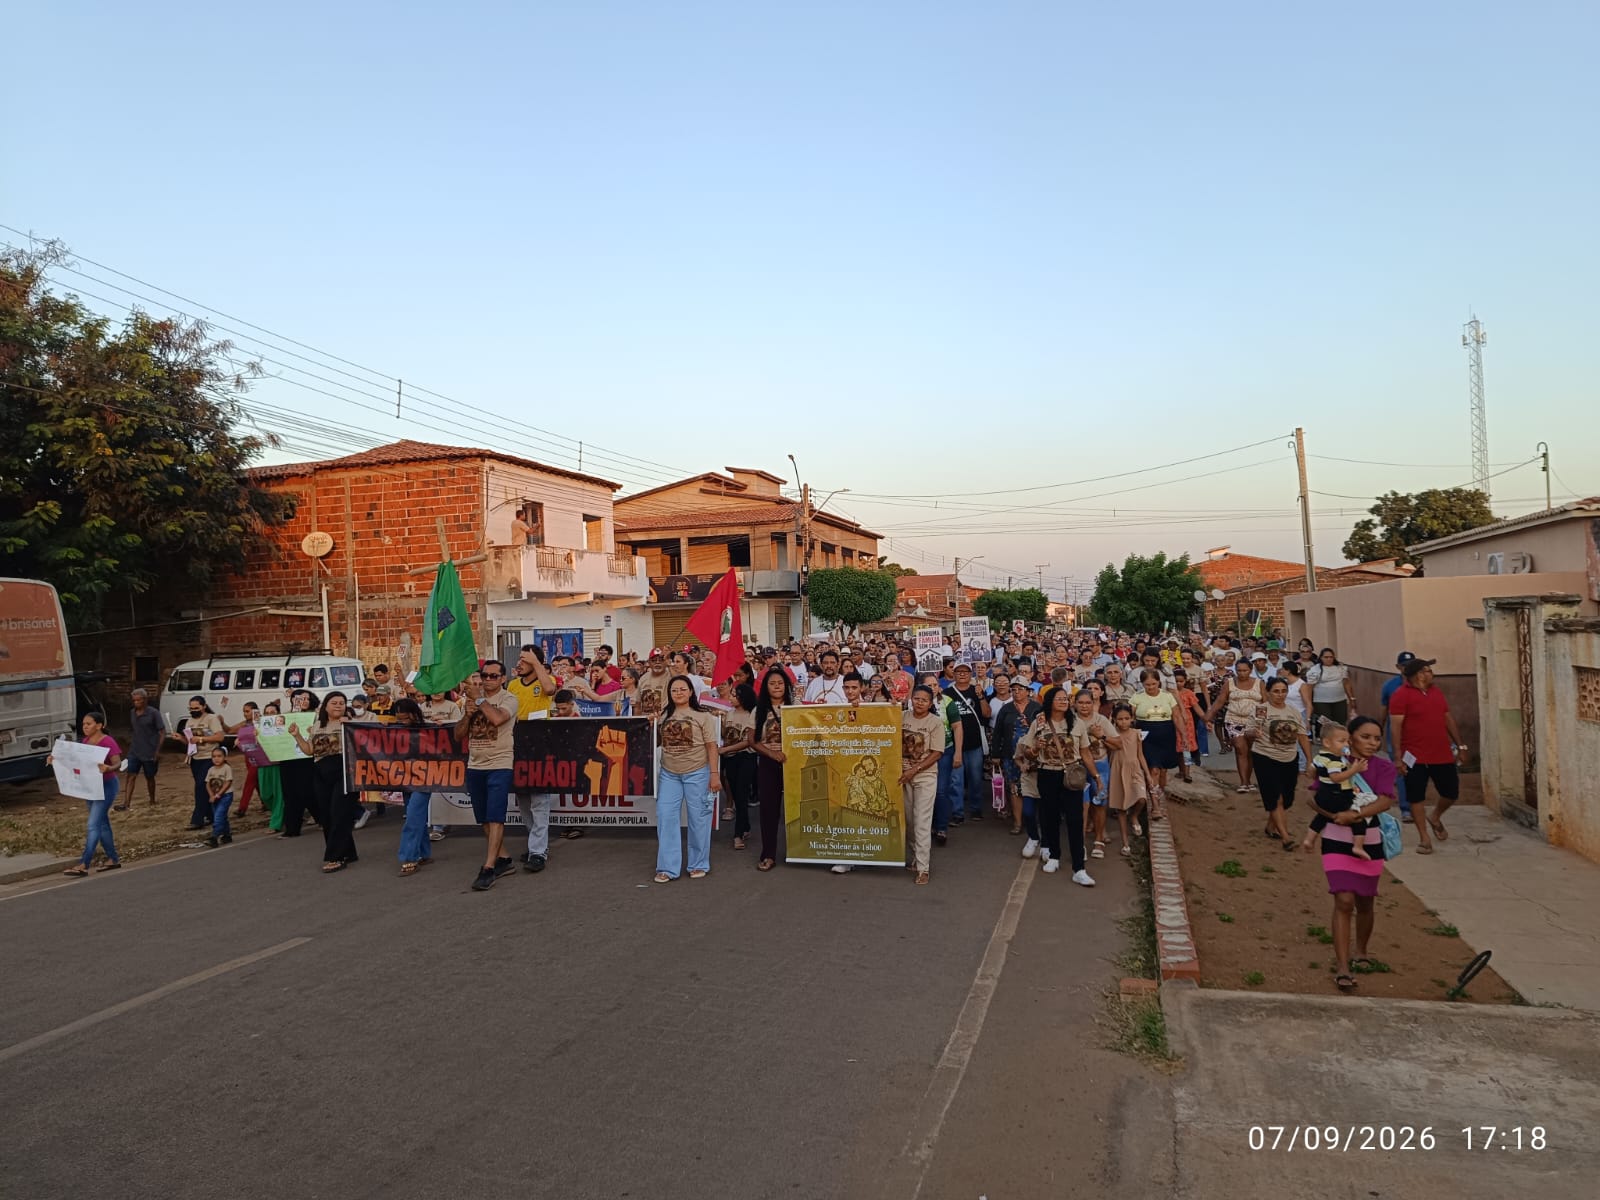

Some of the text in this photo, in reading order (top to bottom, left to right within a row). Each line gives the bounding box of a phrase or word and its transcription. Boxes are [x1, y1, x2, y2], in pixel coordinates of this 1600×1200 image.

[9, 617, 57, 631] brisanet
[354, 728, 410, 755] POVO
[418, 728, 452, 755] NA
[355, 754, 577, 788] FASCISMO CHÃO!
[559, 816, 588, 825] REFORMA
[590, 814, 617, 825] AGRÁRIA
[618, 816, 650, 825] POPULAR.
[802, 824, 889, 837] 10 de Agosto de 2019
[809, 841, 828, 849] Missa
[829, 842, 851, 851] Solene
[862, 843, 882, 852] 18h00
